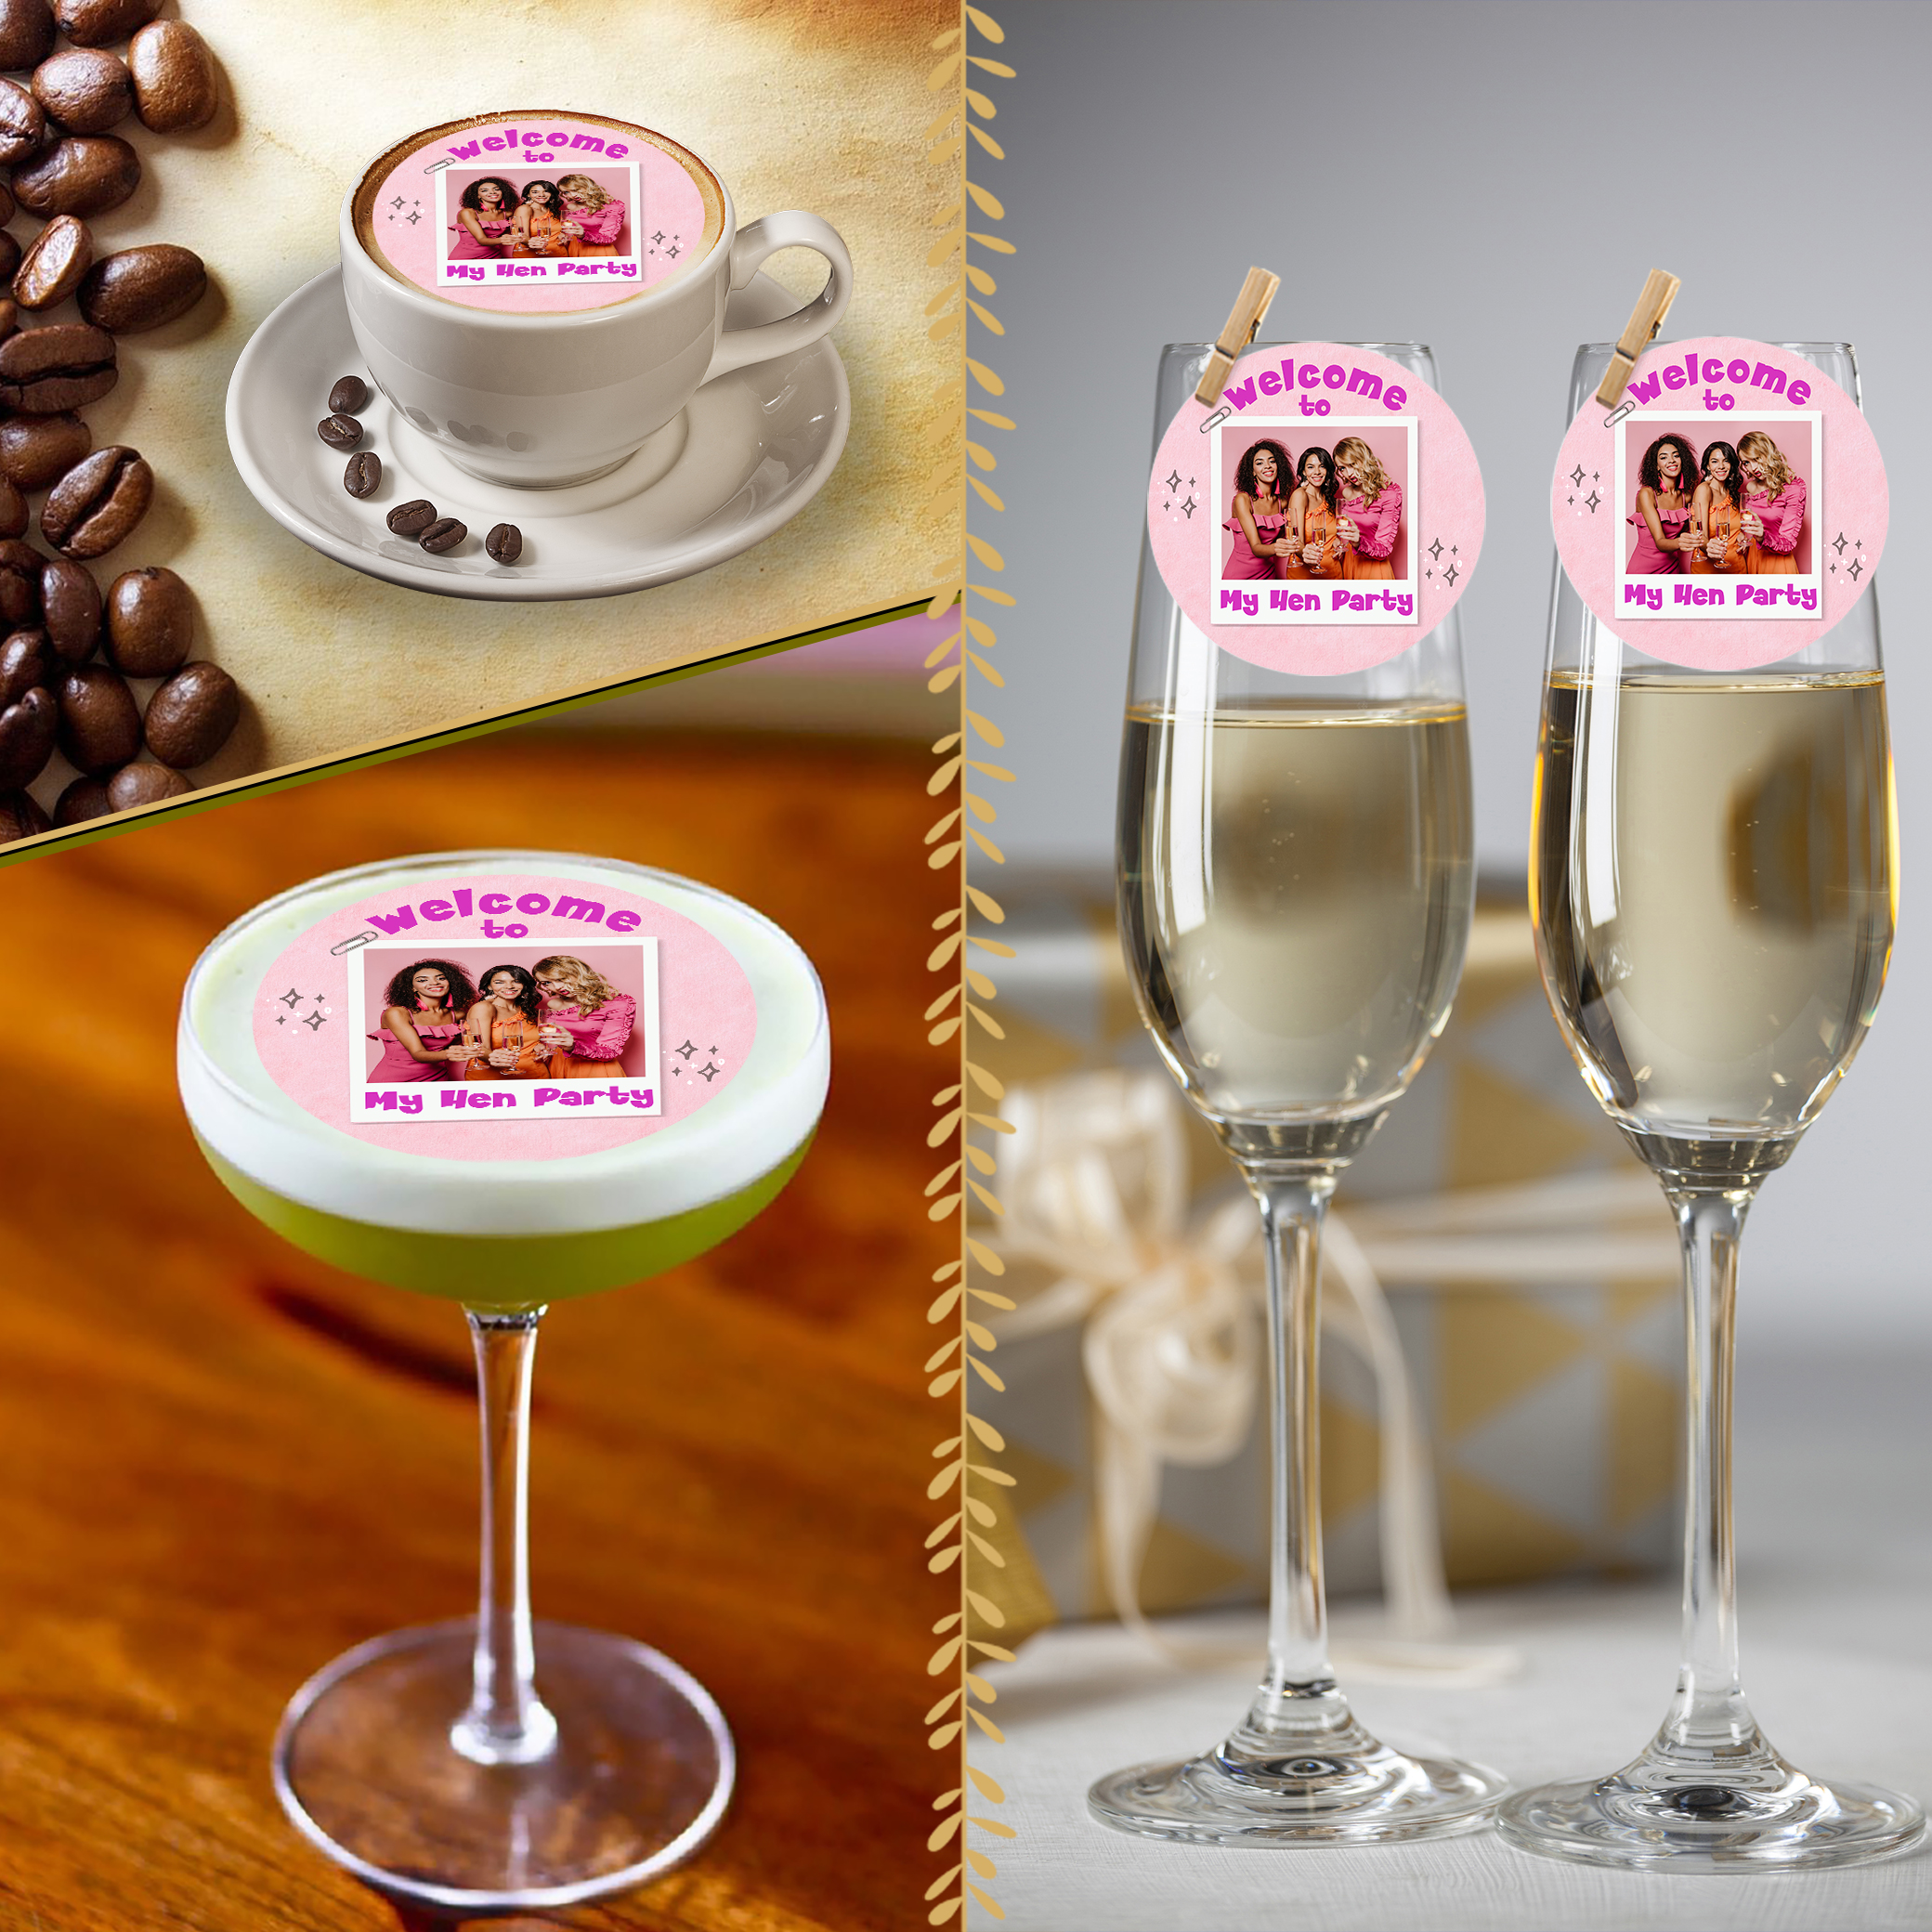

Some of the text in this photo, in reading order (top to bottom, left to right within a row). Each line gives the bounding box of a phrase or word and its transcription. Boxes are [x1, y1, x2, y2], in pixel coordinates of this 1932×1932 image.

[522, 150, 555, 163] to
[446, 261, 637, 281] My Hen Party
[1298, 394, 1331, 417] to
[1702, 388, 1735, 411] to
[1220, 589, 1414, 617] My Hen Party
[1625, 583, 1818, 611] My Hen Party
[479, 919, 529, 939] to
[365, 1086, 654, 1115] My Hen Party
